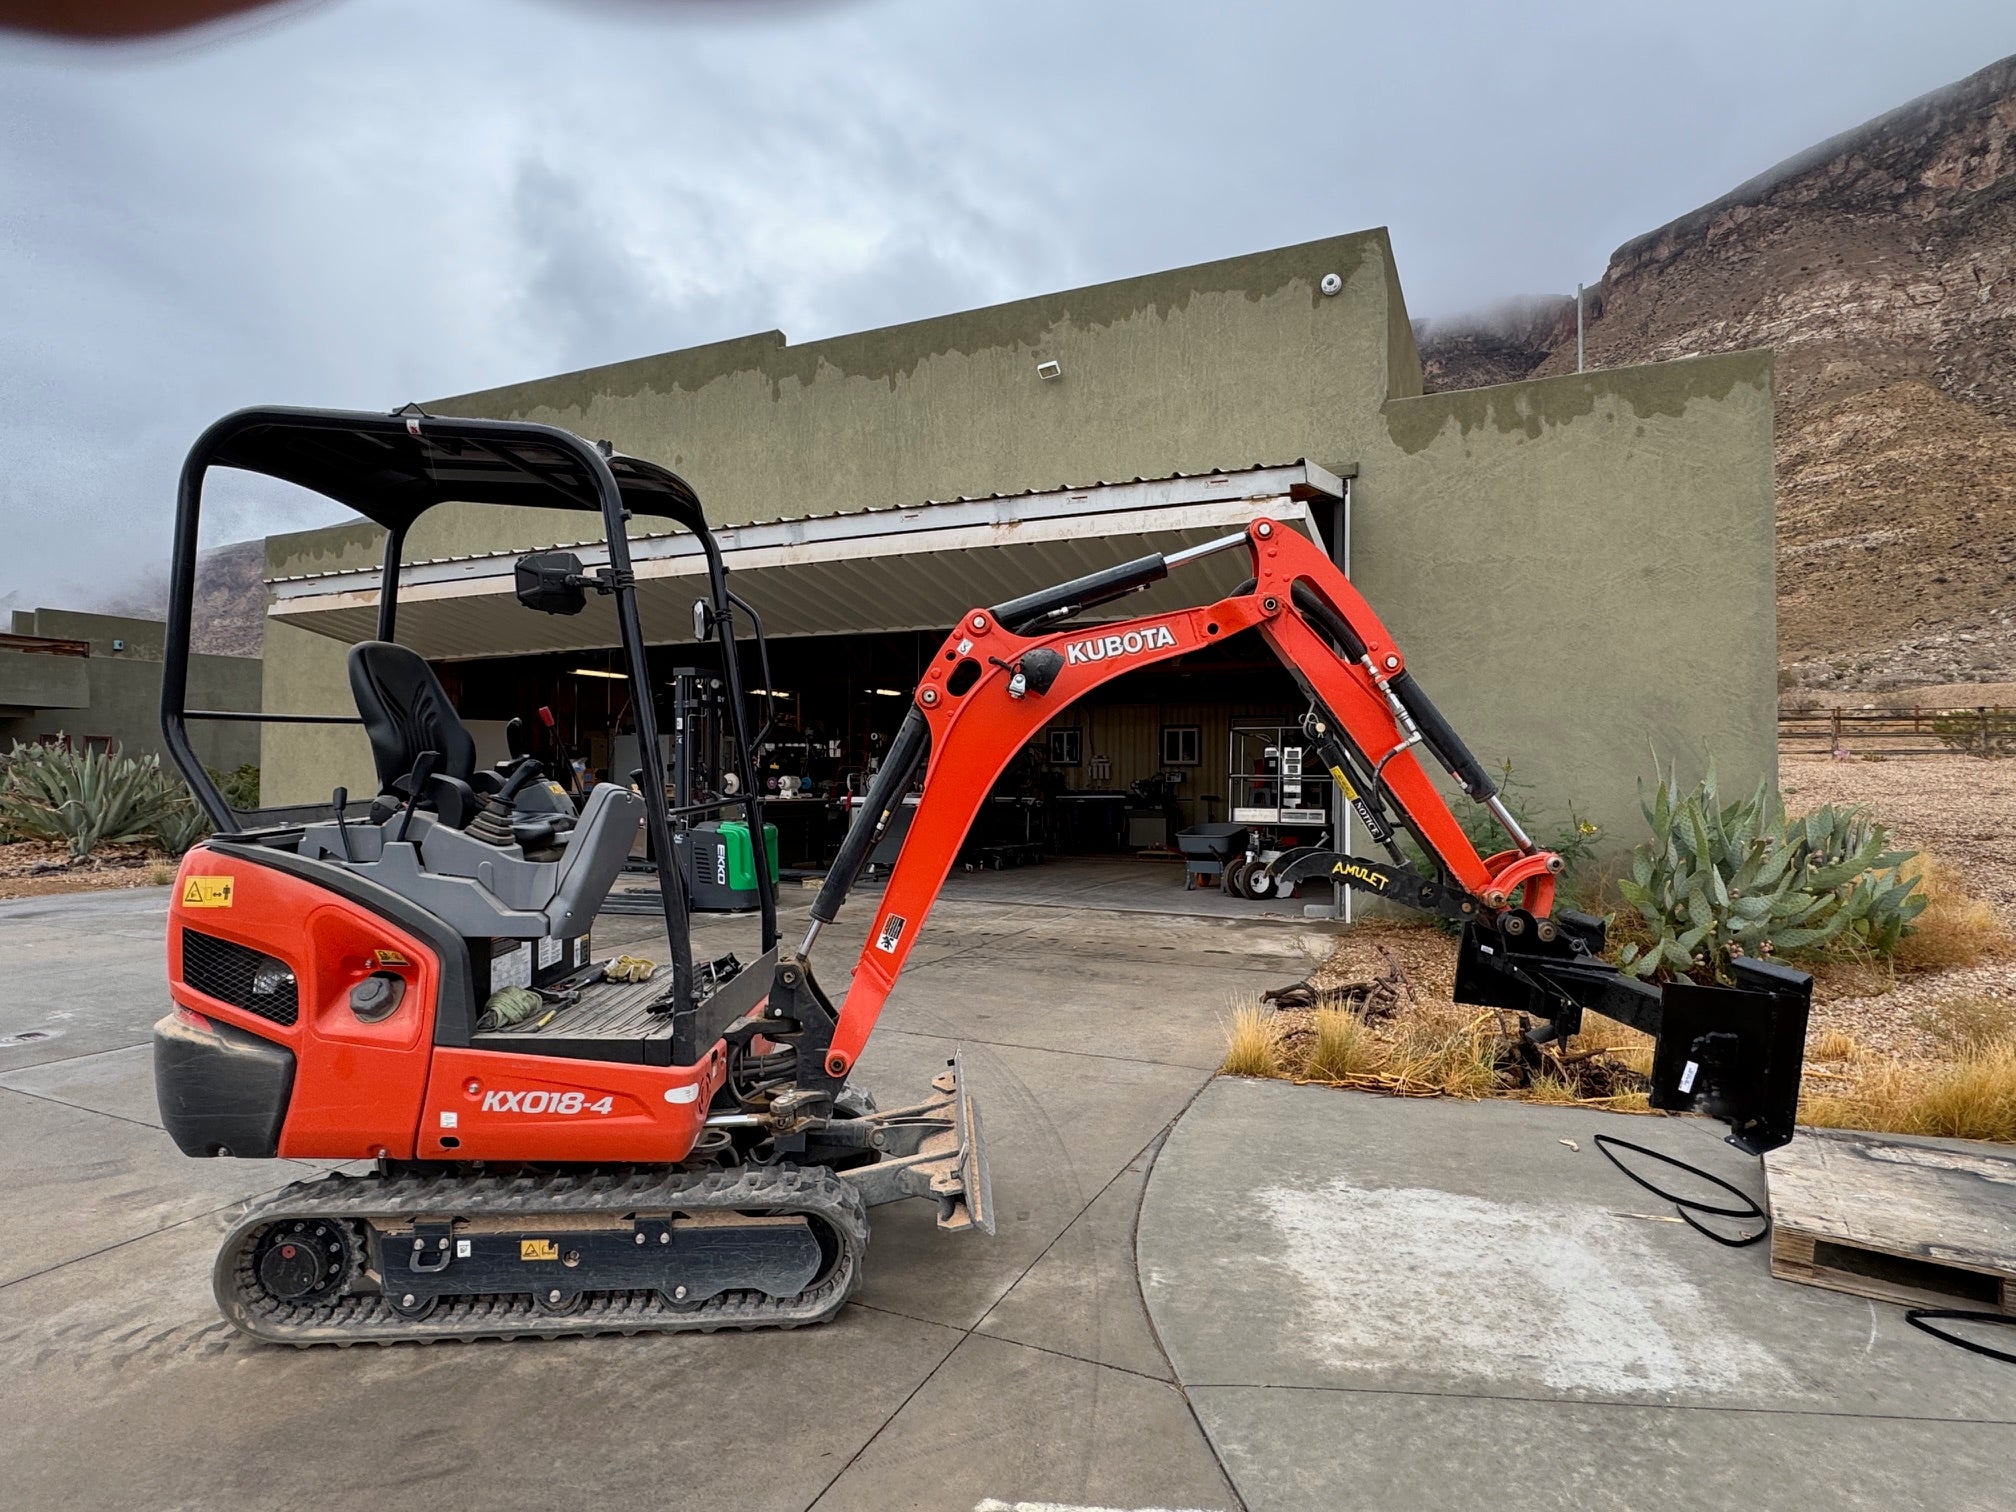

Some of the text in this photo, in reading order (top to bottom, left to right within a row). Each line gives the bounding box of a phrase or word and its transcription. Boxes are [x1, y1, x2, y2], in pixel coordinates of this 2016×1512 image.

[1066, 626, 1176, 665] KUBOTA
[1355, 801, 1380, 834] NOTICE
[717, 844, 726, 885] EKKO
[1332, 861, 1390, 891] AMULET
[481, 1090, 614, 1115] KX018-4
